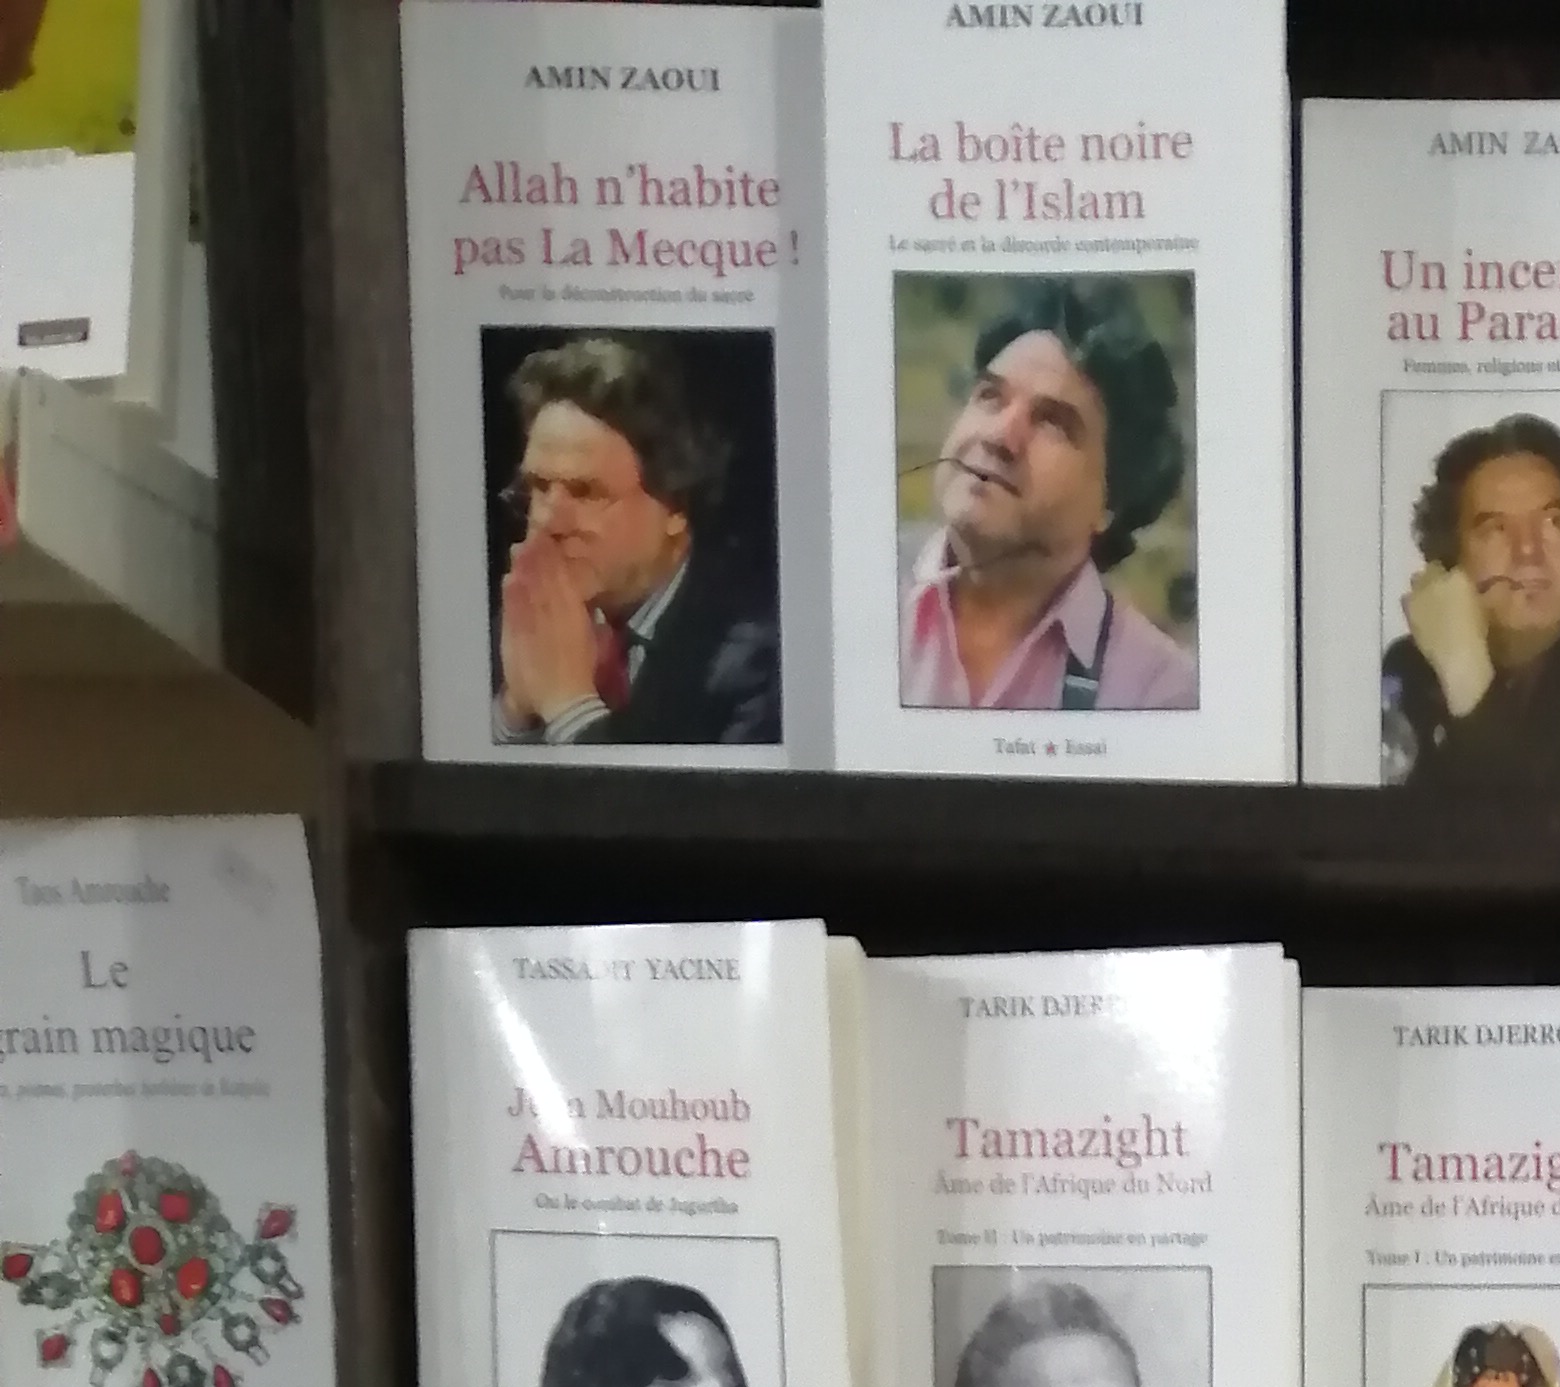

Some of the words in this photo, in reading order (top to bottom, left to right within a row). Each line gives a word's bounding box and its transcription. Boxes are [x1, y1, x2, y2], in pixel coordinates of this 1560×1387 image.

[948, 3, 1033, 28] AMIN
[1042, 3, 1143, 28] ZAOUI
[524, 65, 611, 91] AMIN
[620, 66, 720, 91] ZAOUI
[889, 121, 941, 162] La
[956, 121, 1065, 162] boîte
[1080, 121, 1193, 162] noire
[459, 160, 578, 205] Allah
[595, 162, 781, 208] n'habite
[929, 178, 981, 220] de
[995, 178, 1145, 221] l'Islam
[453, 236, 525, 275] pas
[541, 228, 592, 266] La
[607, 228, 777, 277] Mecque
[789, 230, 799, 265] !
[1380, 249, 1446, 290] Un
[1387, 309, 1440, 341] au
[80, 950, 129, 989] Le
[0, 1014, 78, 1064] rain
[92, 1013, 256, 1064] magique
[1394, 1025, 1468, 1047] TARIK
[596, 1088, 751, 1122] Mouhoub
[511, 1133, 751, 1179] Amrouche
[946, 1113, 1190, 1170] Tamazight
